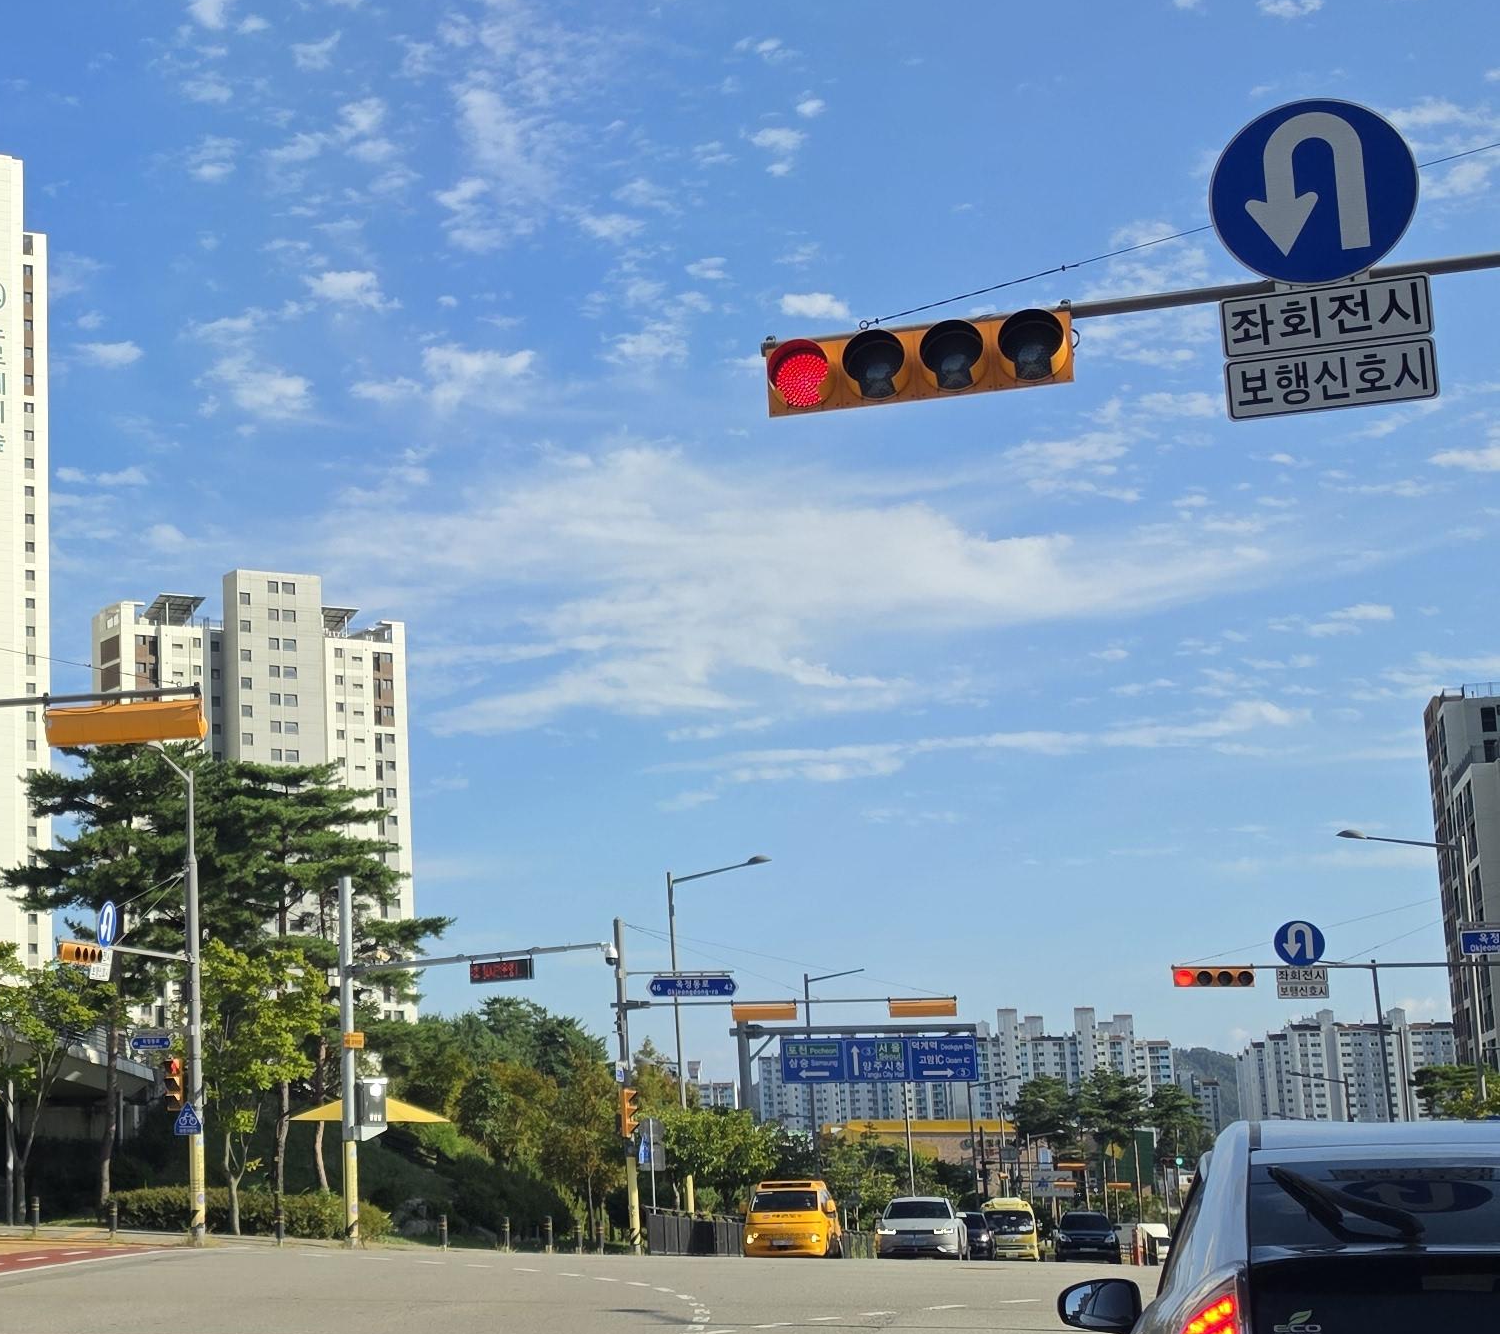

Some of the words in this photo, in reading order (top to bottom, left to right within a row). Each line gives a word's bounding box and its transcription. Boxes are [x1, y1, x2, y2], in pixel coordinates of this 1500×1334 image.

[1231, 282, 1422, 346] 좌회전시
[1238, 347, 1428, 406] 보행신호시
[1479, 932, 1500, 945] 옥정
[1278, 969, 1325, 981] 좌회전시
[652, 984, 661, 992] 46
[676, 979, 710, 989] 옥정동로
[724, 983, 733, 991] 42
[1280, 985, 1327, 997] 보행신호시
[879, 1042, 900, 1053] 서울
[863, 1061, 905, 1072] 양주시청
[1273, 1324, 1322, 1333] ECO
